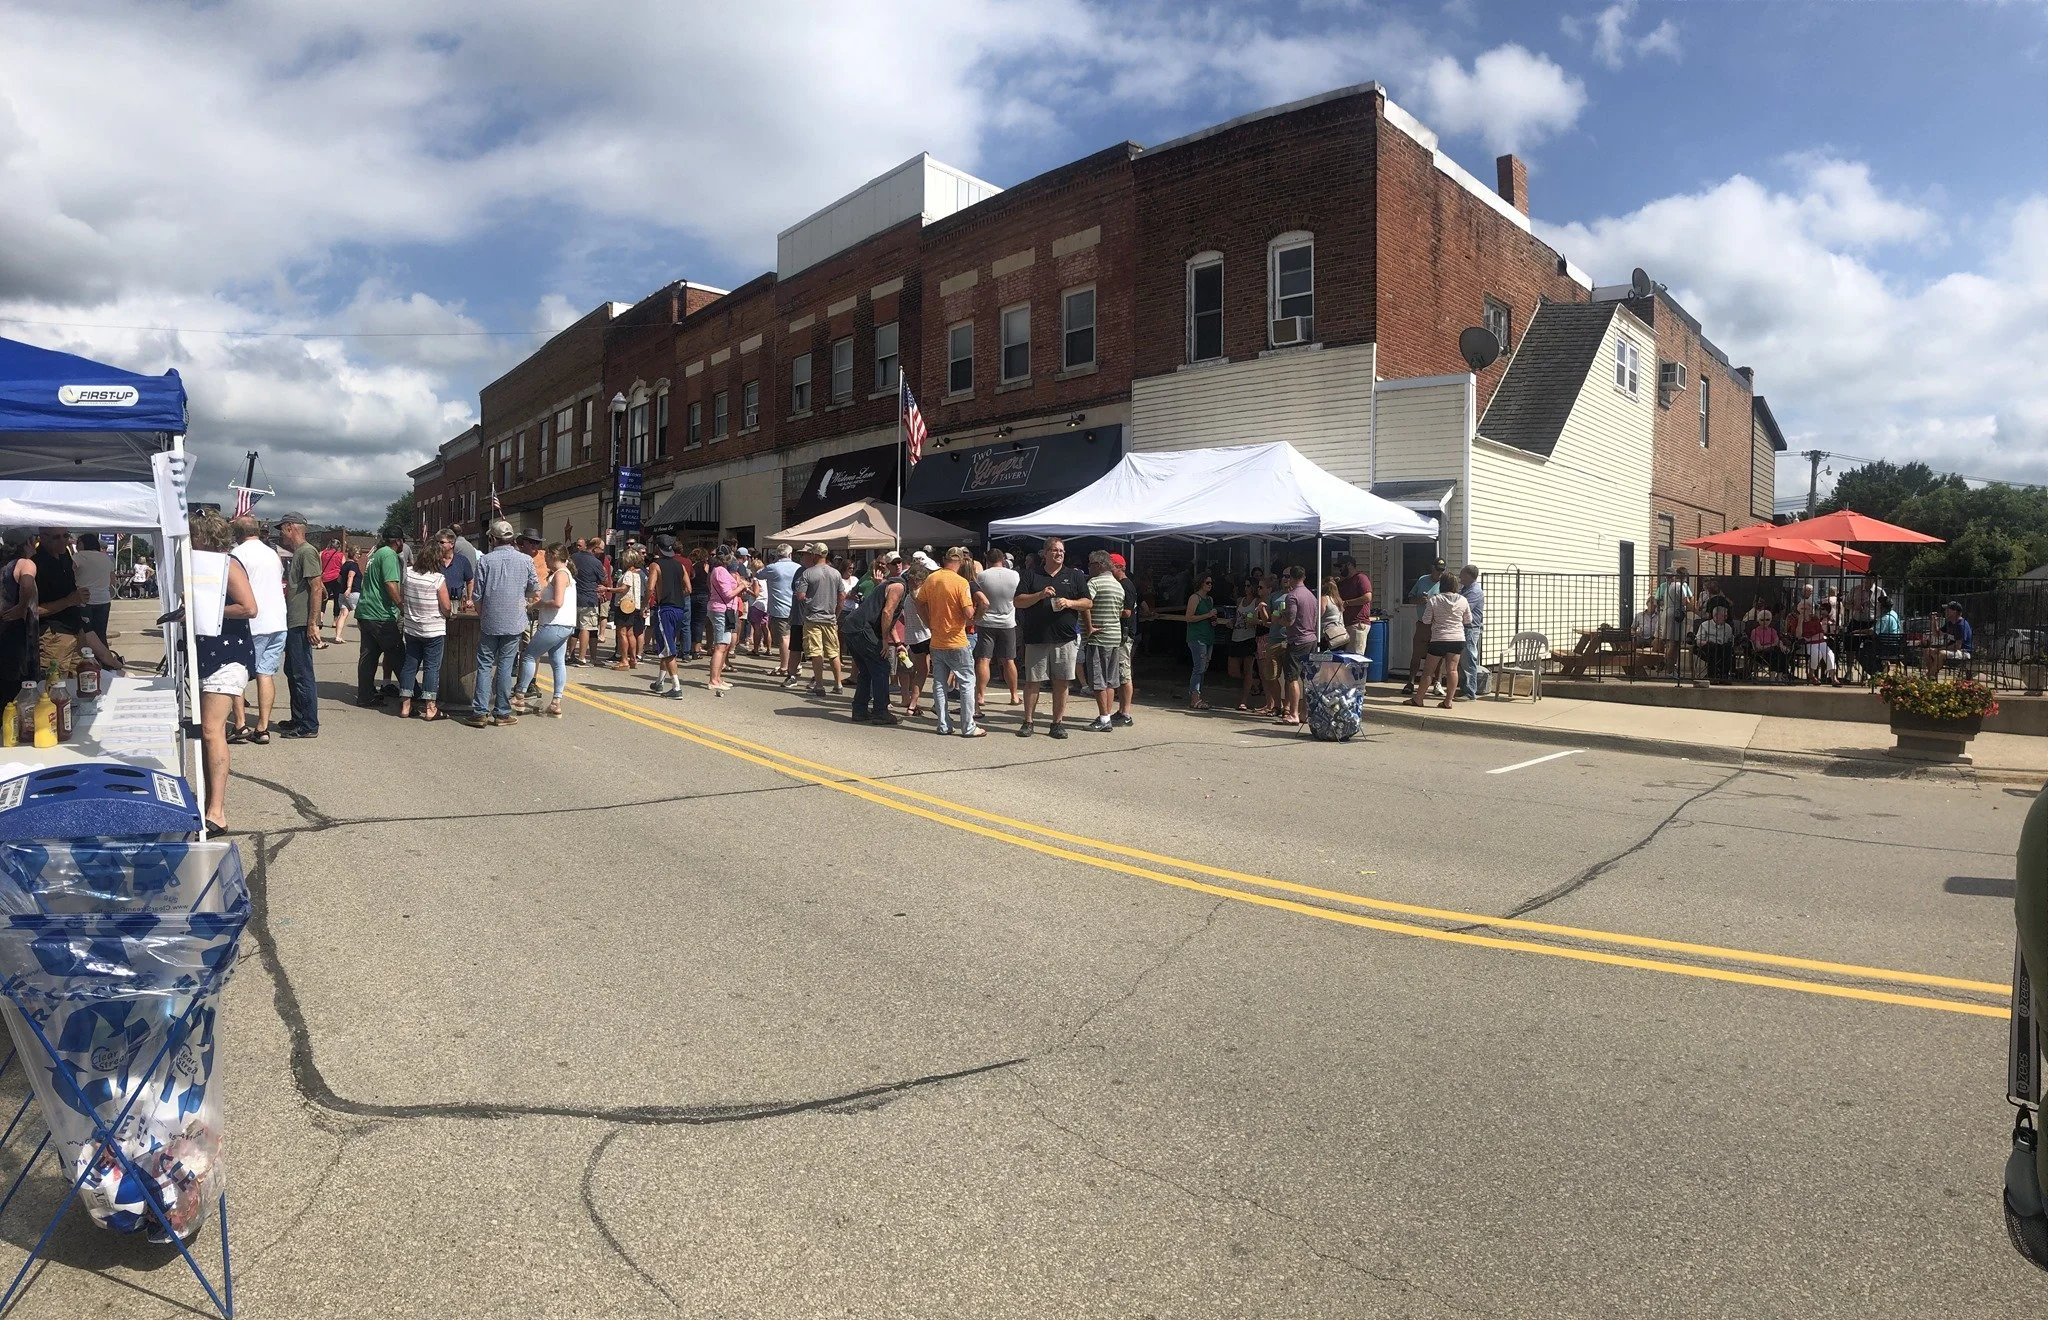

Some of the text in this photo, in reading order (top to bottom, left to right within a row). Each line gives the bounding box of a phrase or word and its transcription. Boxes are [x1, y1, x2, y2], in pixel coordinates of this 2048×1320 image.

[79, 391, 134, 400] FIRST-UP
[972, 448, 993, 464] TWO
[1000, 471, 1028, 481] TAVERN
